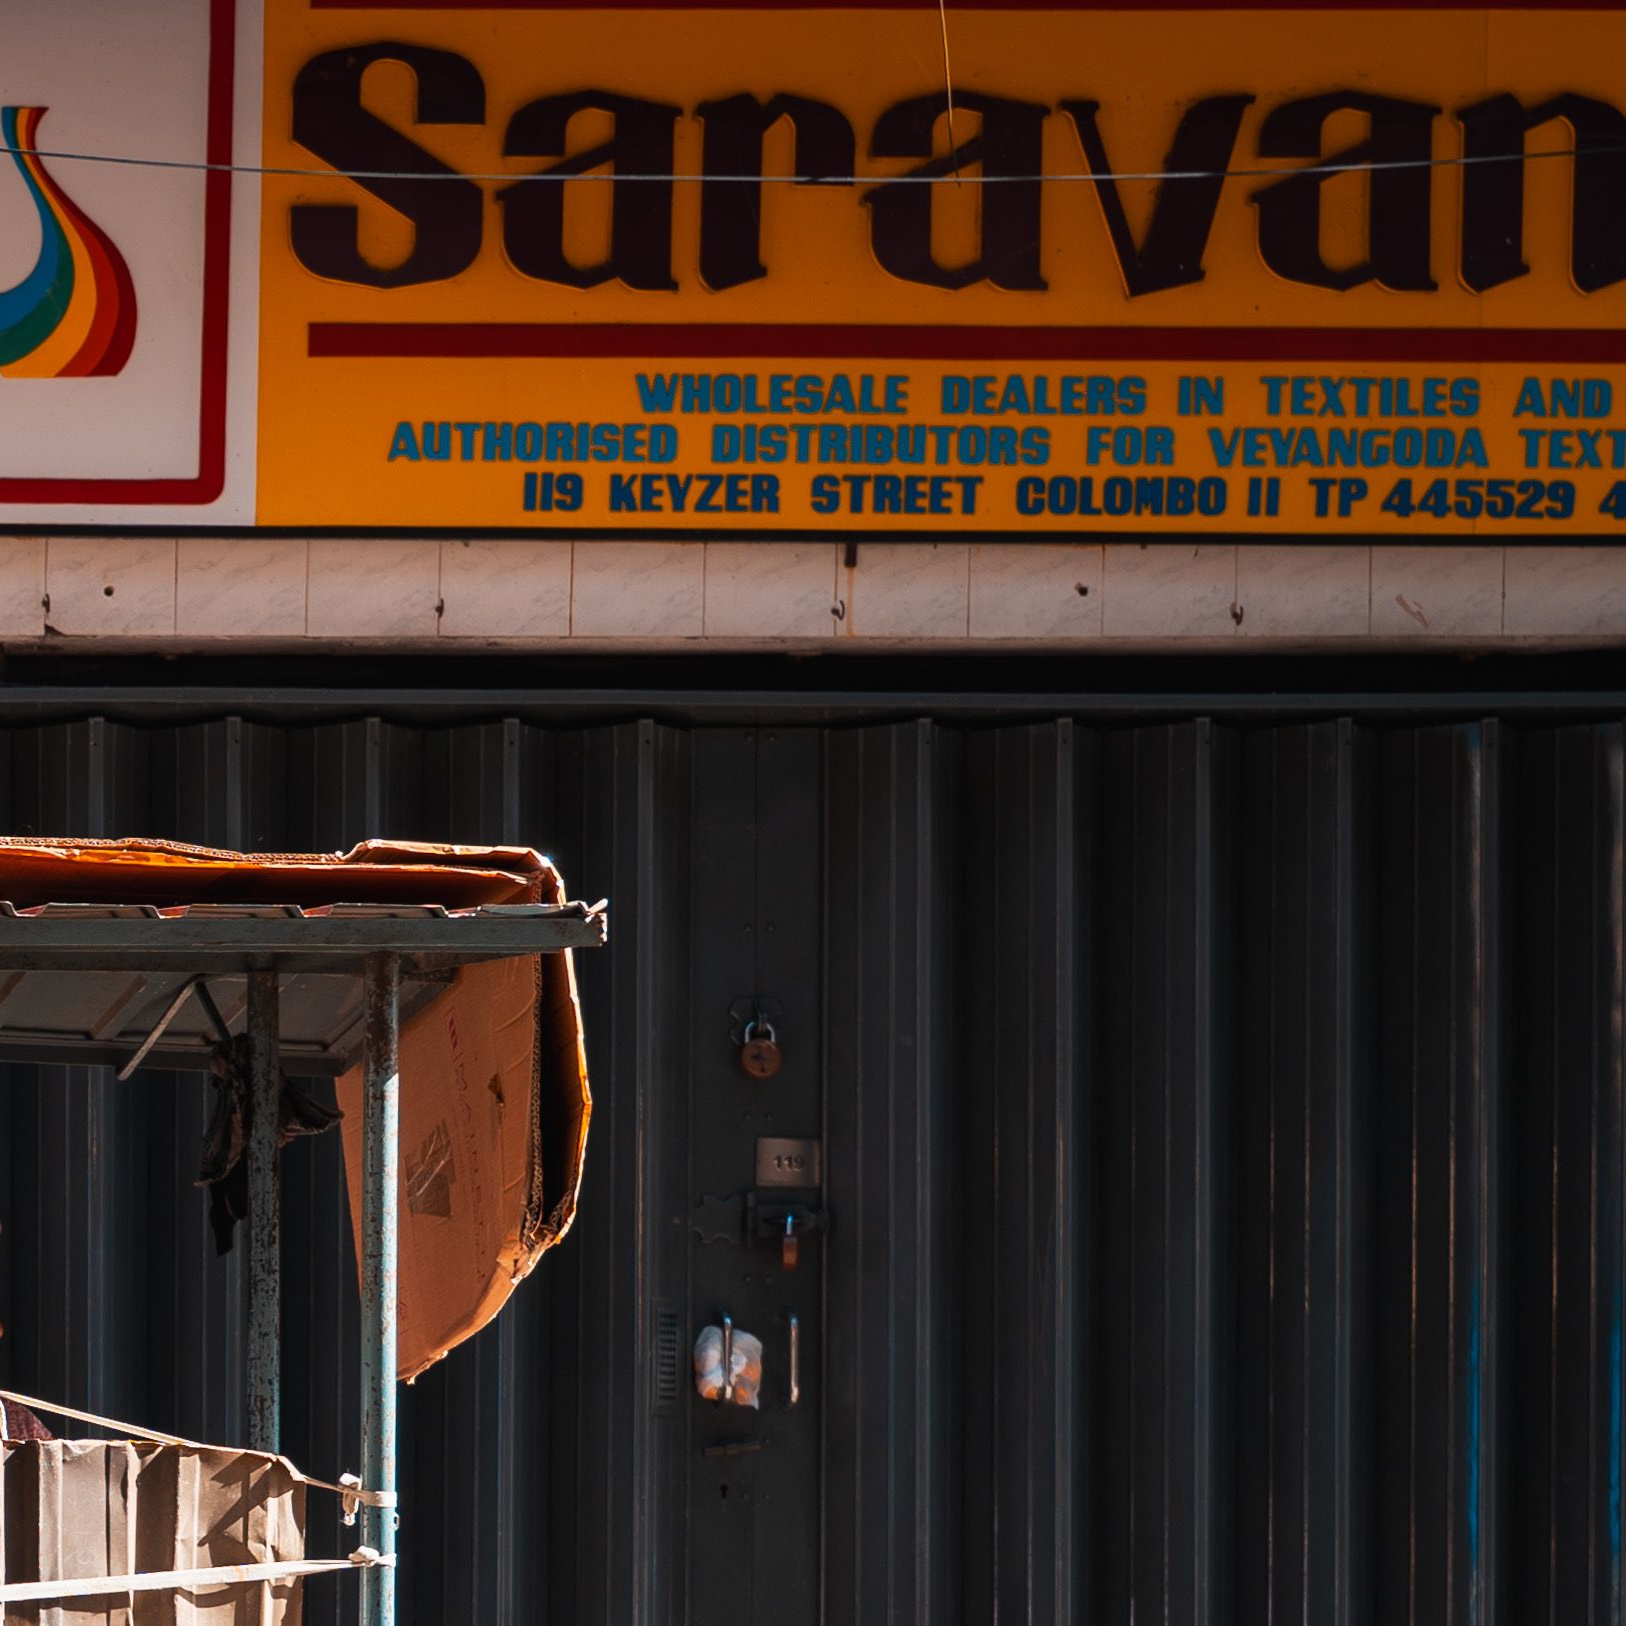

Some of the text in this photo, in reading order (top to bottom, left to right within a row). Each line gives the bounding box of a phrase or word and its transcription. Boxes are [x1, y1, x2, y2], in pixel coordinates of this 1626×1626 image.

[635, 374, 1612, 417] WHOLESALE DEALERS IN TEXTILES AND
[388, 422, 679, 464] AUTHORISED
[711, 424, 1051, 466] DISTRIBUTORS
[1086, 427, 1176, 467] FOR
[1208, 428, 1489, 469] VEYANGODA
[609, 473, 780, 515] KEYZER
[811, 474, 984, 516] STREET
[1016, 475, 1228, 517] COLOMBO
[1308, 477, 1369, 518] TP
[1382, 478, 1576, 520] 445529
